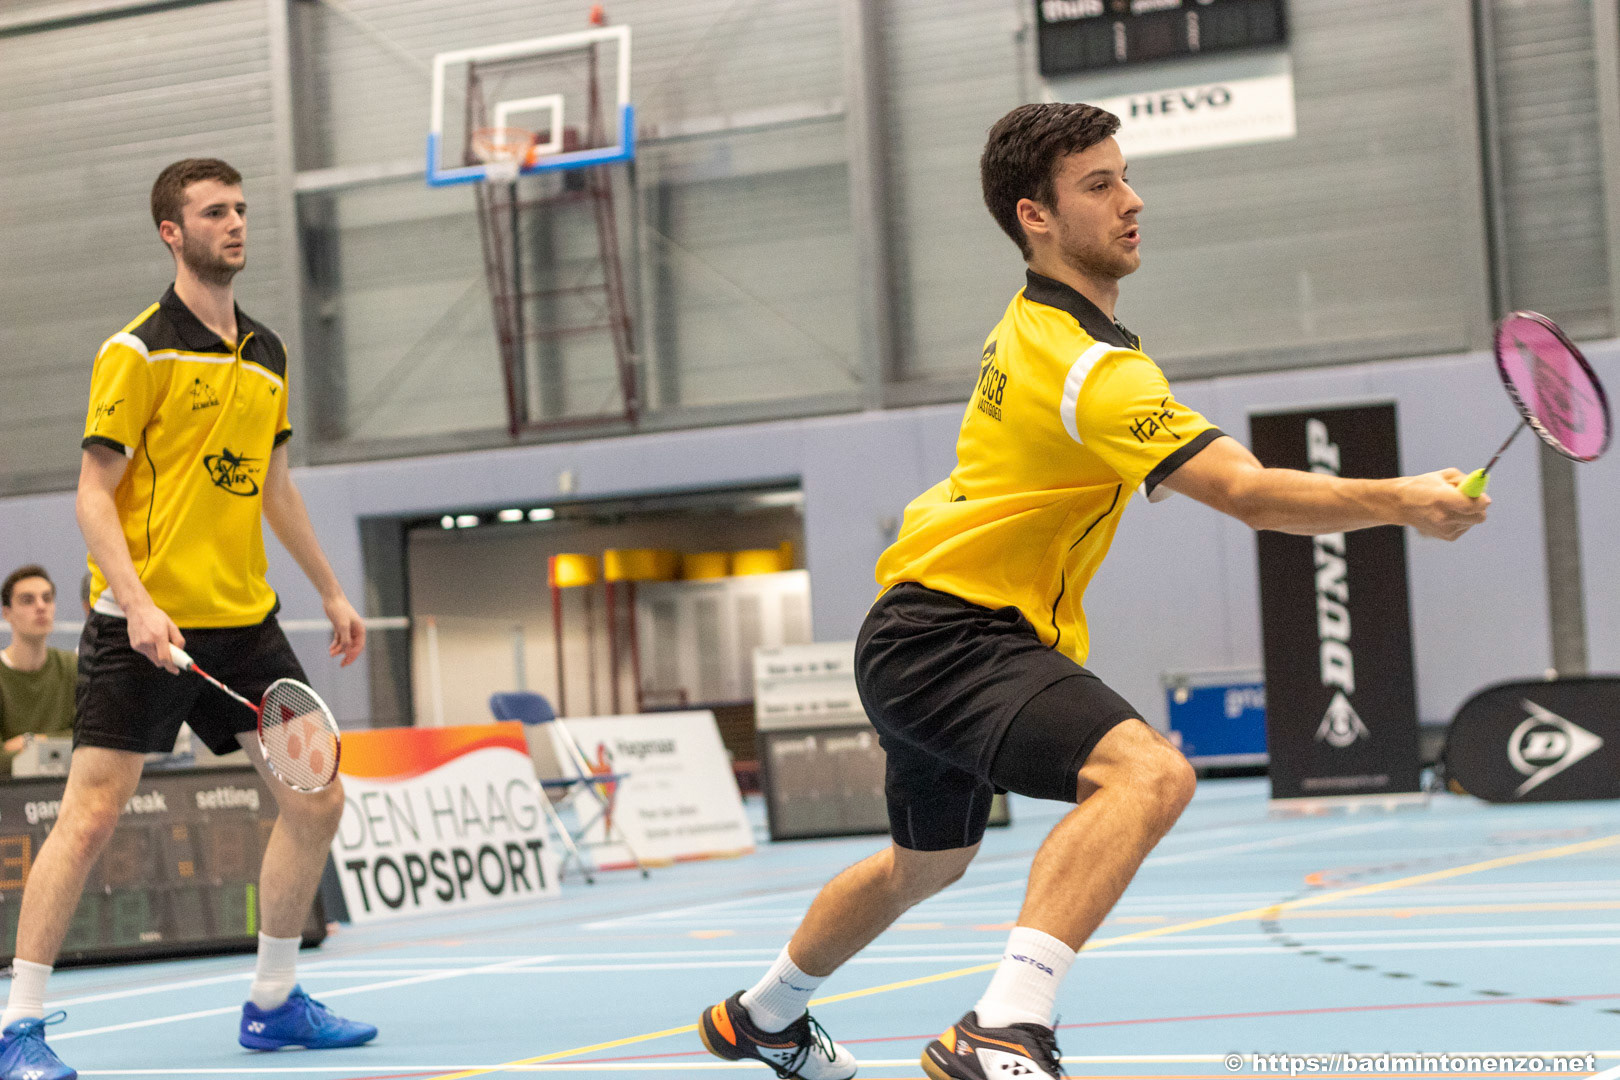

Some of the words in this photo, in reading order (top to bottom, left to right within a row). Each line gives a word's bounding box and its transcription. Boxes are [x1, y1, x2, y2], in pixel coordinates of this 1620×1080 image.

[1129, 86, 1232, 118] HEVO
[982, 366, 1007, 406] SCB
[1305, 417, 1356, 696] DUNP
[196, 785, 260, 812] setting
[338, 791, 420, 851] DEN
[424, 778, 539, 842] HAAG
[345, 838, 546, 912] TOPSPORT
[1011, 953, 1054, 976] VICTOR
